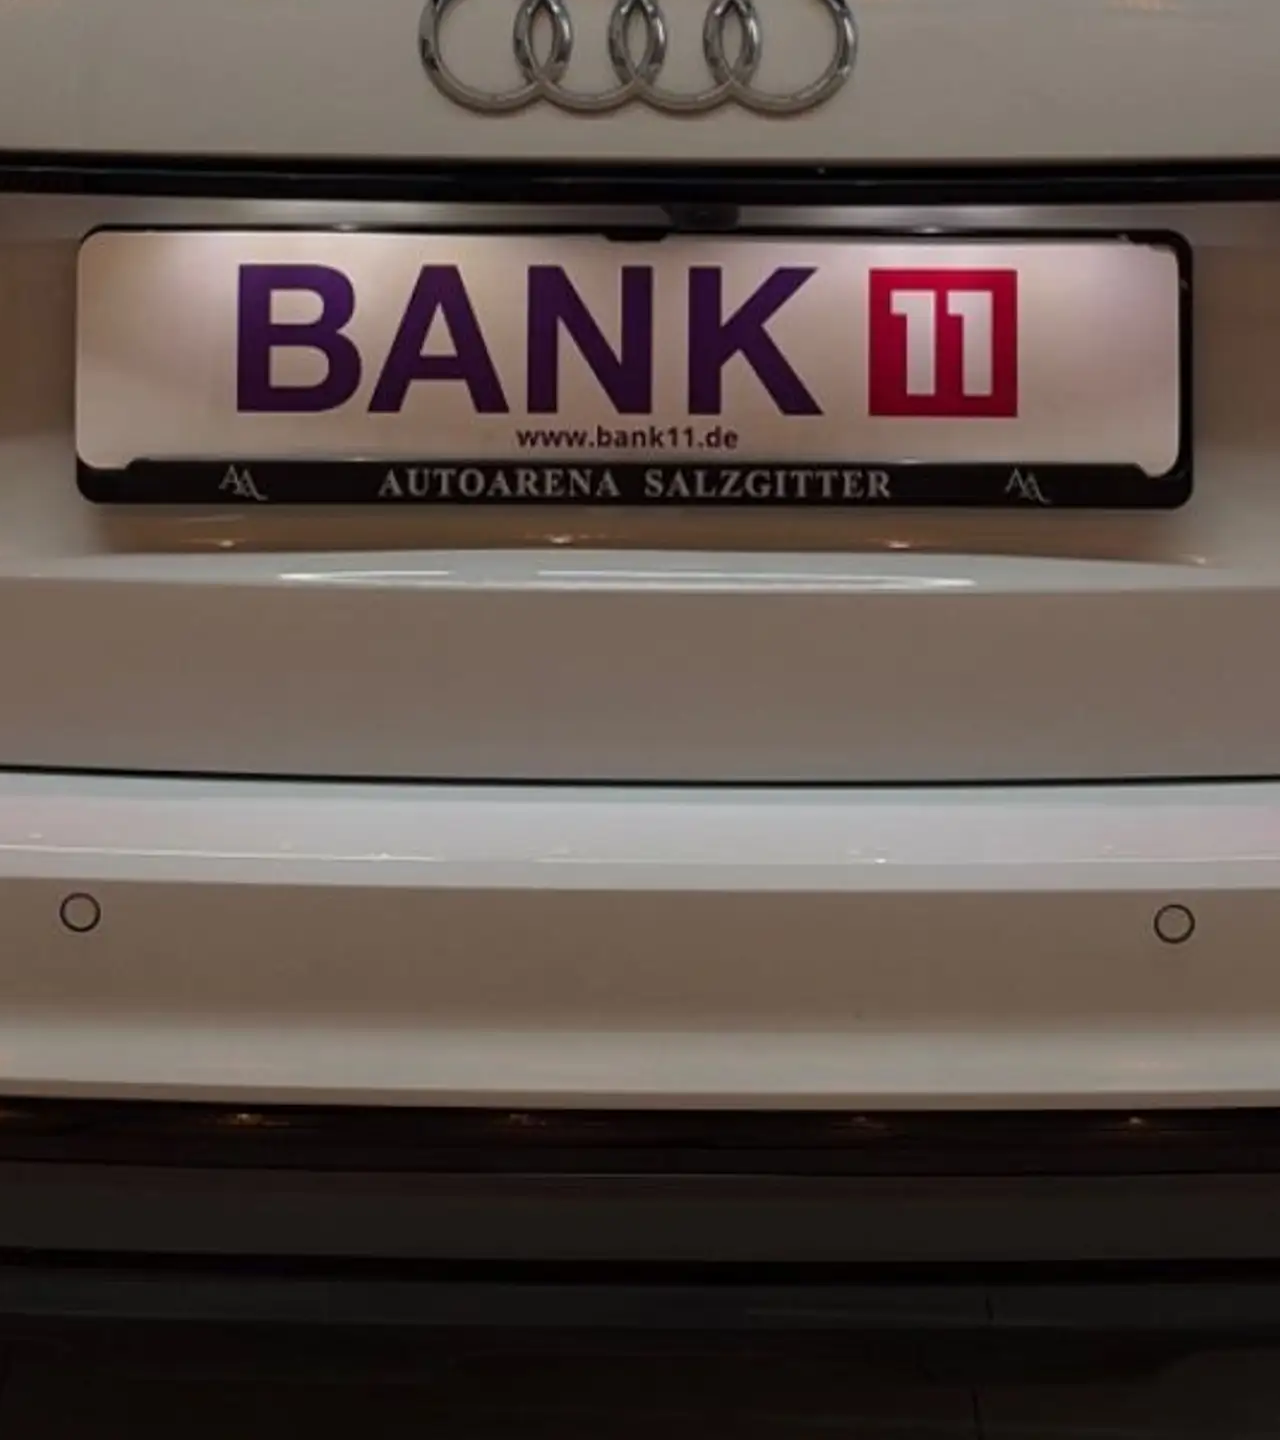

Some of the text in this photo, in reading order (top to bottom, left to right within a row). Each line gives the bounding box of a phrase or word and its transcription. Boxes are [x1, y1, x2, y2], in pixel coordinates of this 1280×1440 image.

[236, 264, 994, 416] BANK 11
[516, 425, 738, 449] www.bank11.de
[378, 467, 620, 498] AUTOARENA
[644, 467, 892, 499] SALZGITTER
